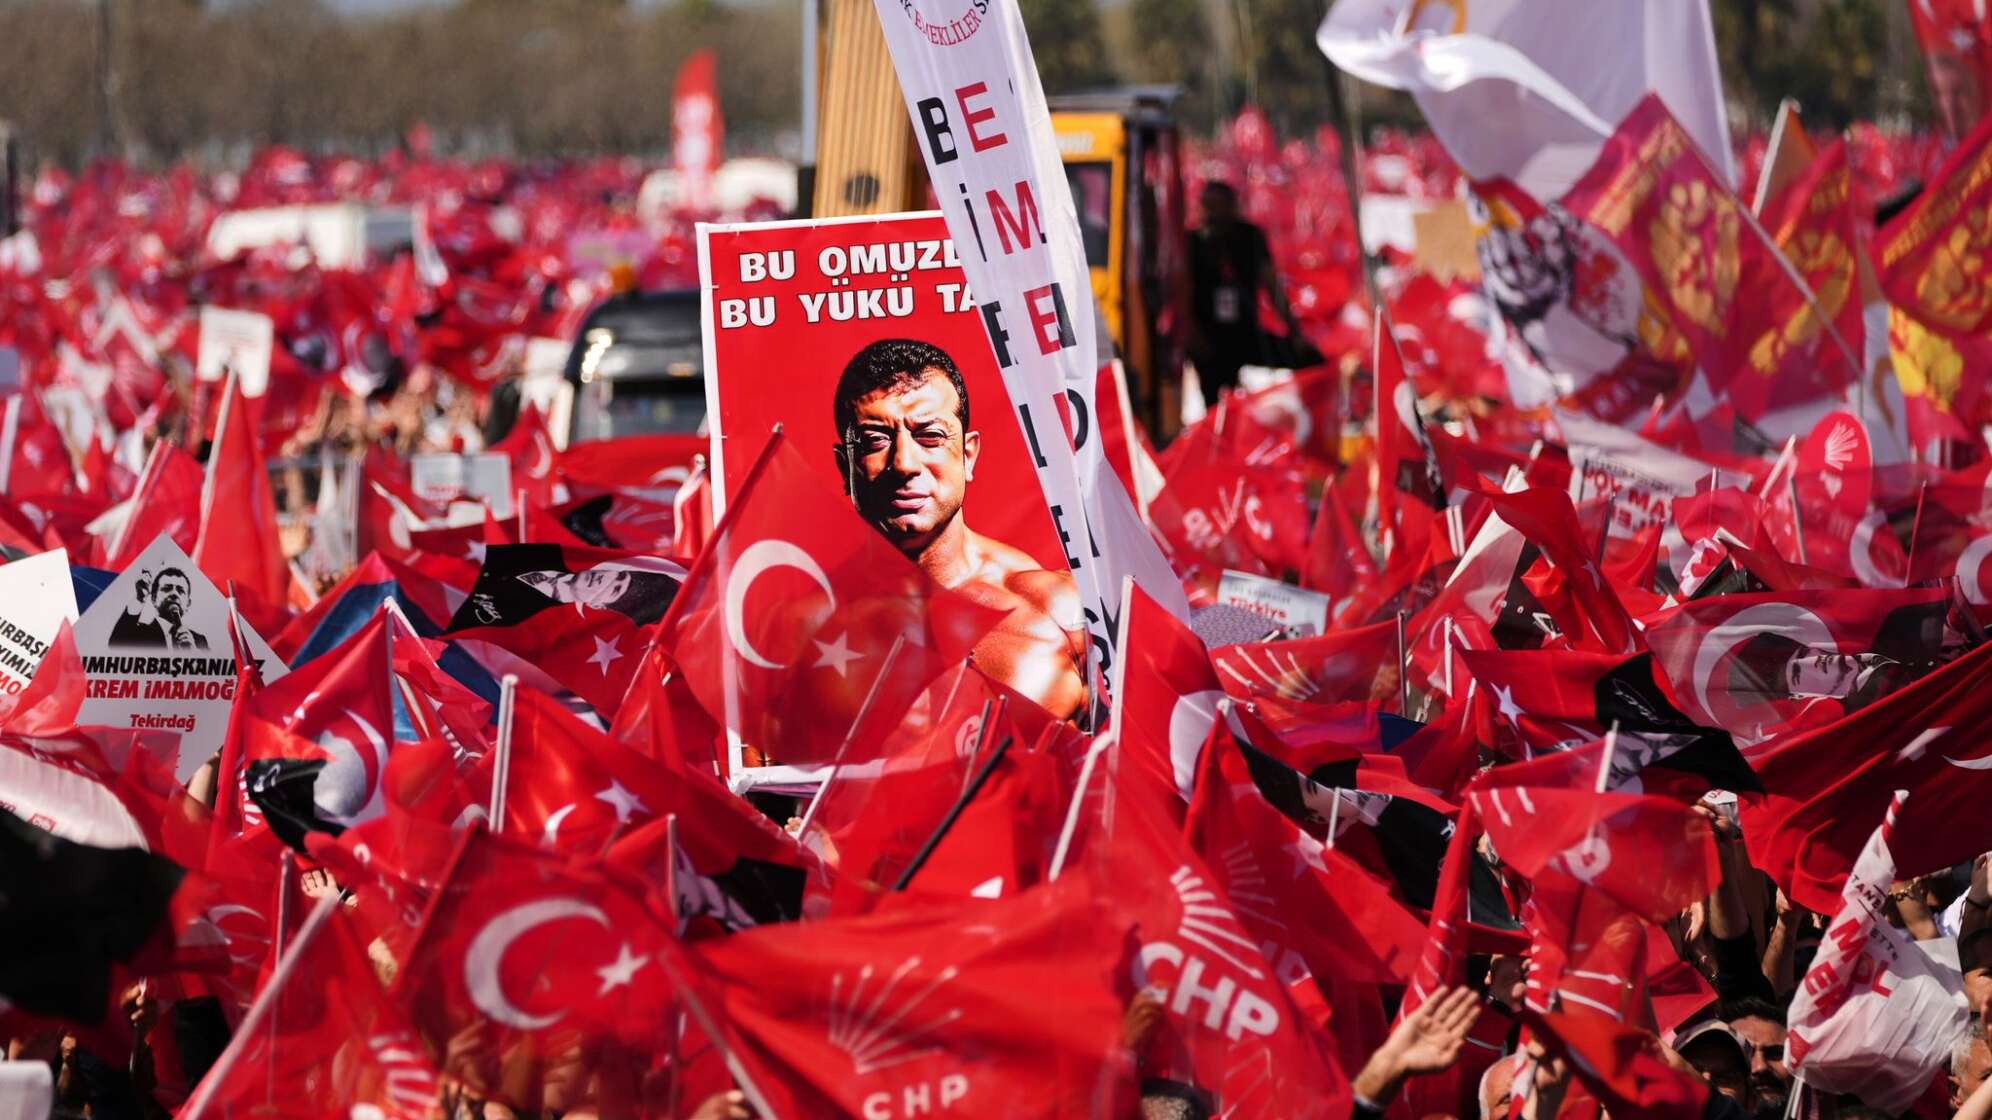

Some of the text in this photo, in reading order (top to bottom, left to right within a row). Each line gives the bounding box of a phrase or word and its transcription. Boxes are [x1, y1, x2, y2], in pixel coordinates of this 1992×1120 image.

[739, 250, 797, 283] BU
[720, 296, 777, 329] BU
[798, 273, 915, 323] YÜKÜ
[86, 679, 238, 701] KREM İMAMOĞ
[130, 713, 196, 732] Tekirdağ
[1131, 941, 1280, 1042] CHP
[863, 1073, 969, 1120] CHP
